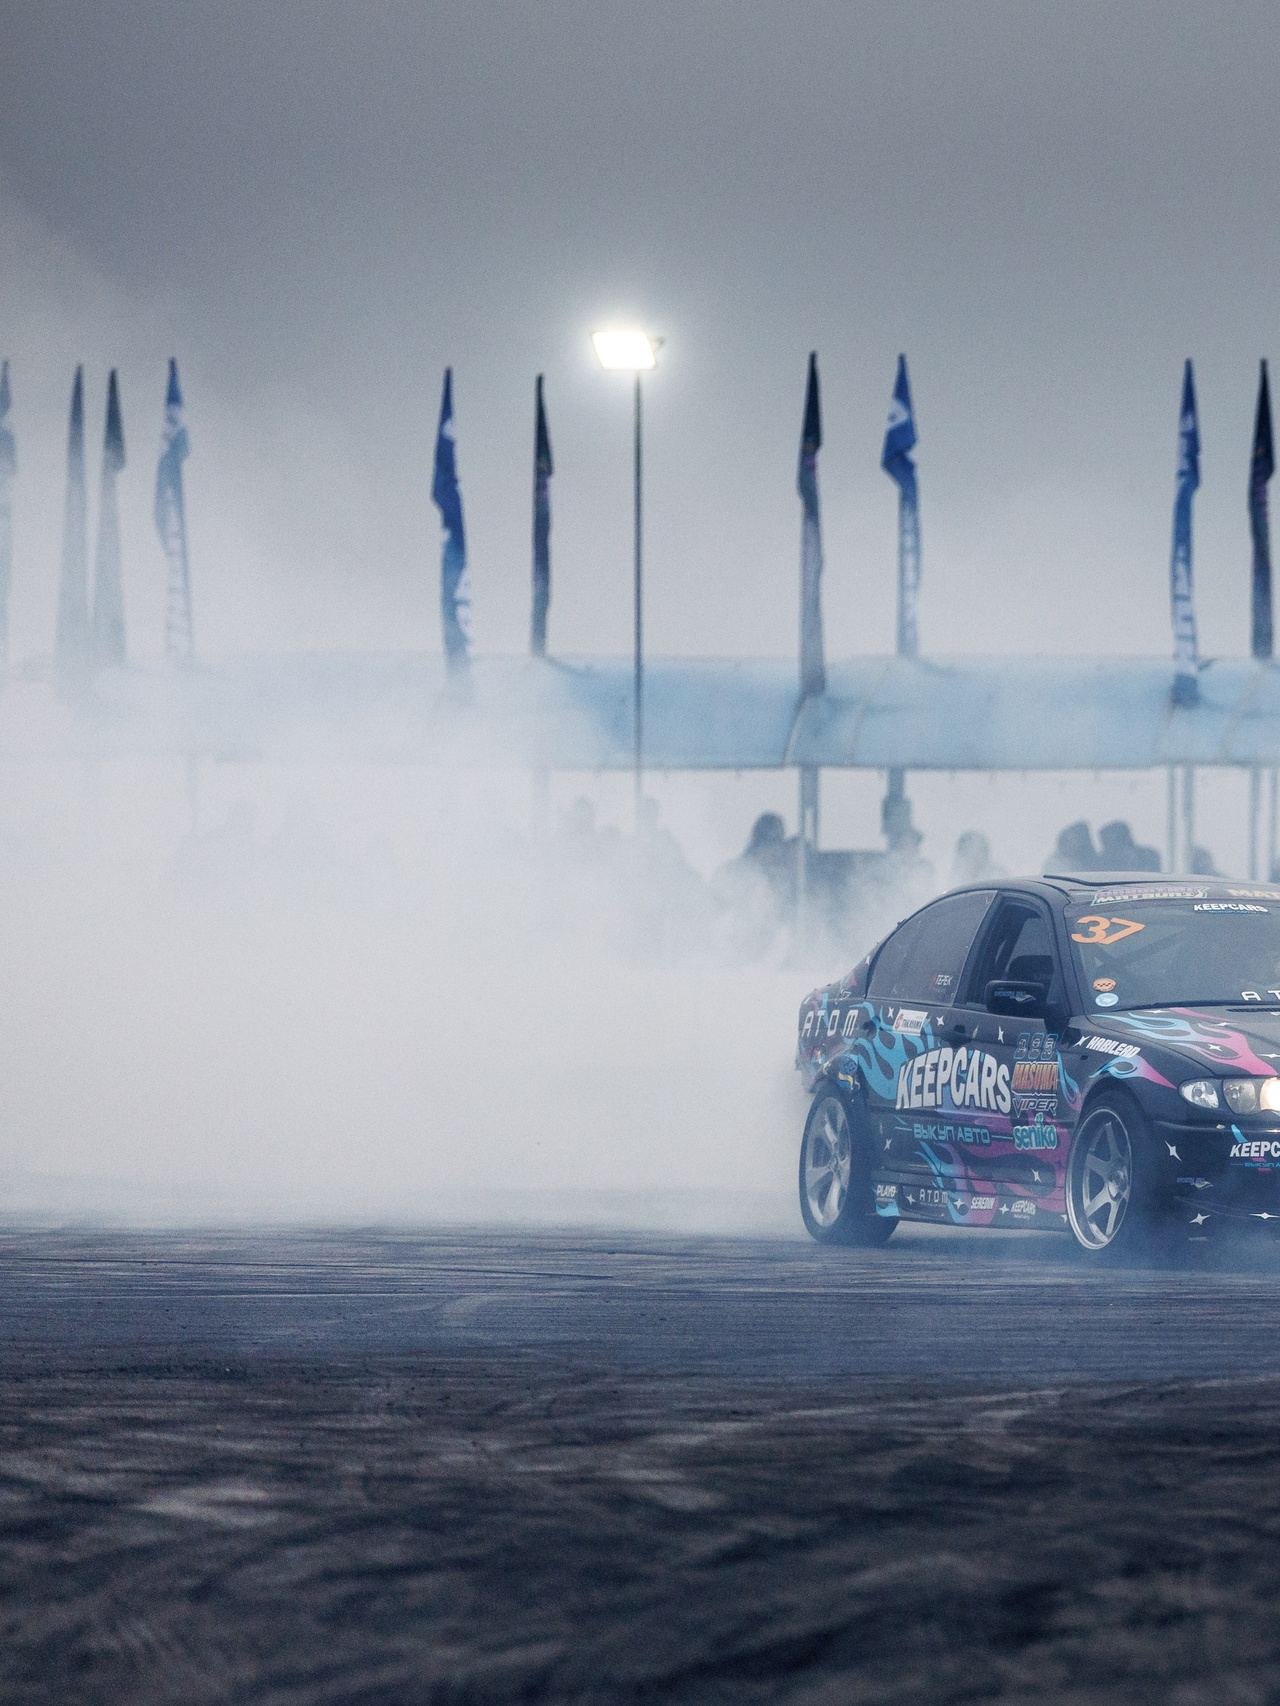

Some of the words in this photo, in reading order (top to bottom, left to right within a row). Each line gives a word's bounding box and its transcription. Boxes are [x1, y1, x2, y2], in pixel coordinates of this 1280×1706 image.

[1194, 903, 1269, 912] KEEPCARS
[1071, 916, 1146, 945] 37
[801, 1009, 859, 1037] ATOM
[1086, 1036, 1141, 1058] HABILEAD
[896, 1047, 1011, 1114] KEEPCARS
[1012, 1063, 1058, 1091] MASUMA
[1012, 1098, 1058, 1118] VIPER
[914, 1123, 956, 1141] ВЫКУП
[957, 1127, 991, 1144] АВТО
[919, 1188, 948, 1203] ATOM
[1010, 1200, 1036, 1216] KEEPCARS
